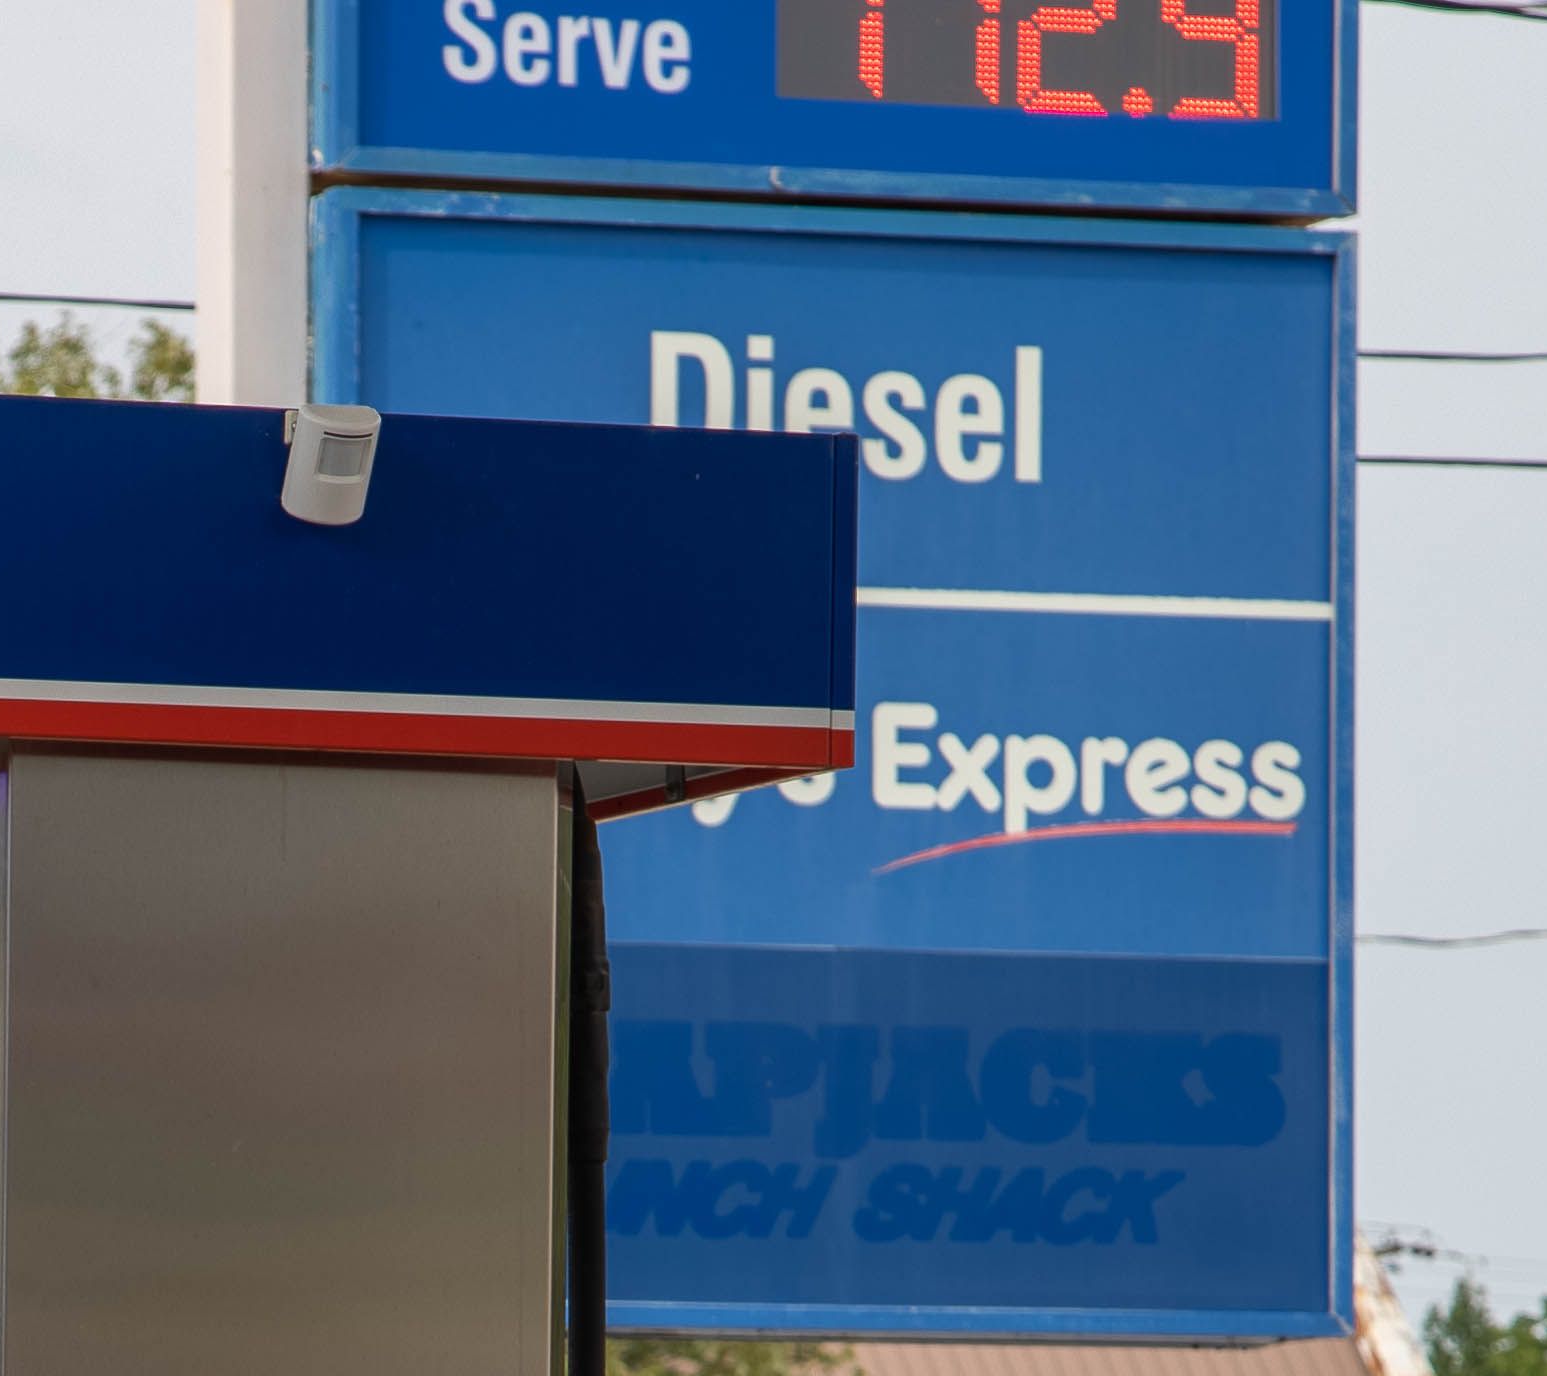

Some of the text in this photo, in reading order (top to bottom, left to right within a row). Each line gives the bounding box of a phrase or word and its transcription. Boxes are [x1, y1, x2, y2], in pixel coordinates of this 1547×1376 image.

[443, 0, 691, 93] Serve
[651, 330, 1042, 483] Diesel
[871, 702, 1306, 835] Express
[608, 1019, 1286, 1158] APJACKS
[852, 1162, 1186, 1245] SHACK
